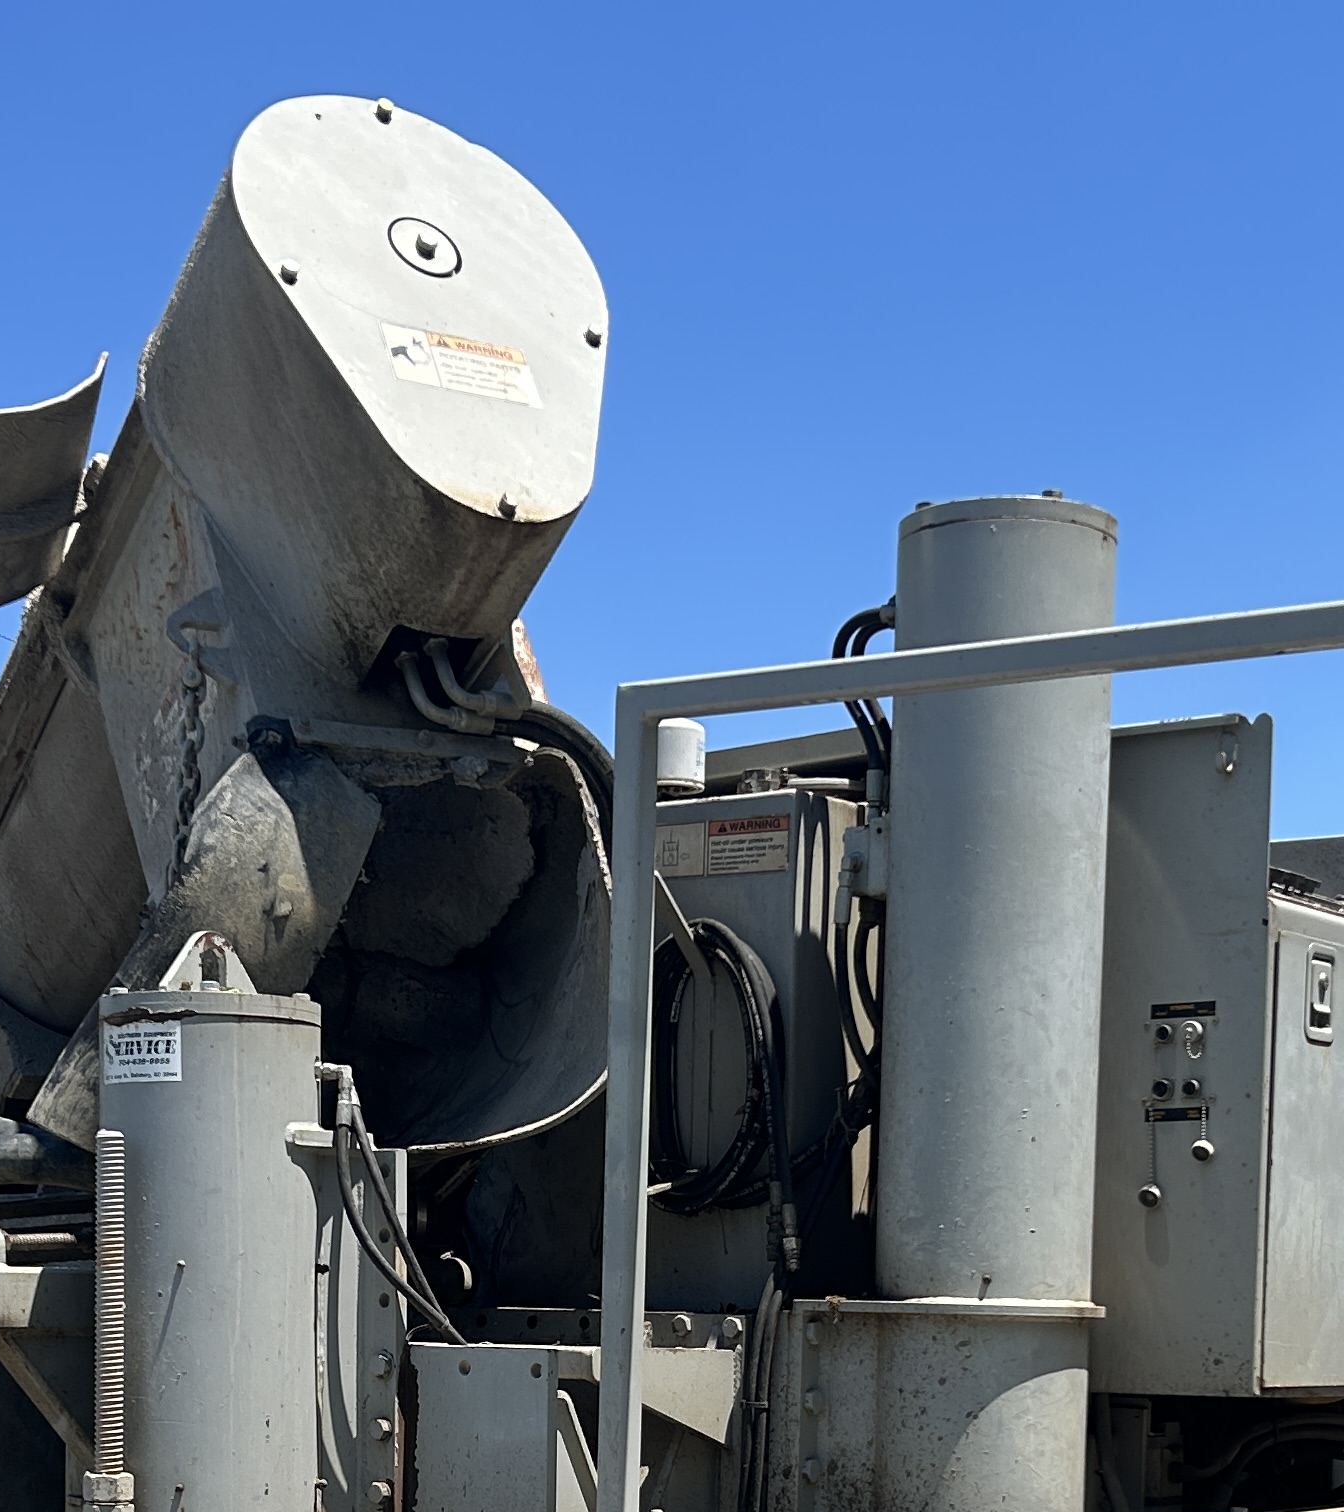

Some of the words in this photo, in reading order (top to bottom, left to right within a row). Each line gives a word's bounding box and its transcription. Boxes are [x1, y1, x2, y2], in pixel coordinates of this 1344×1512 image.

[454, 341, 513, 360] WARNING
[439, 352, 486, 367] ROTATING
[489, 361, 521, 375] PARTS
[728, 818, 781, 832] WARNING
